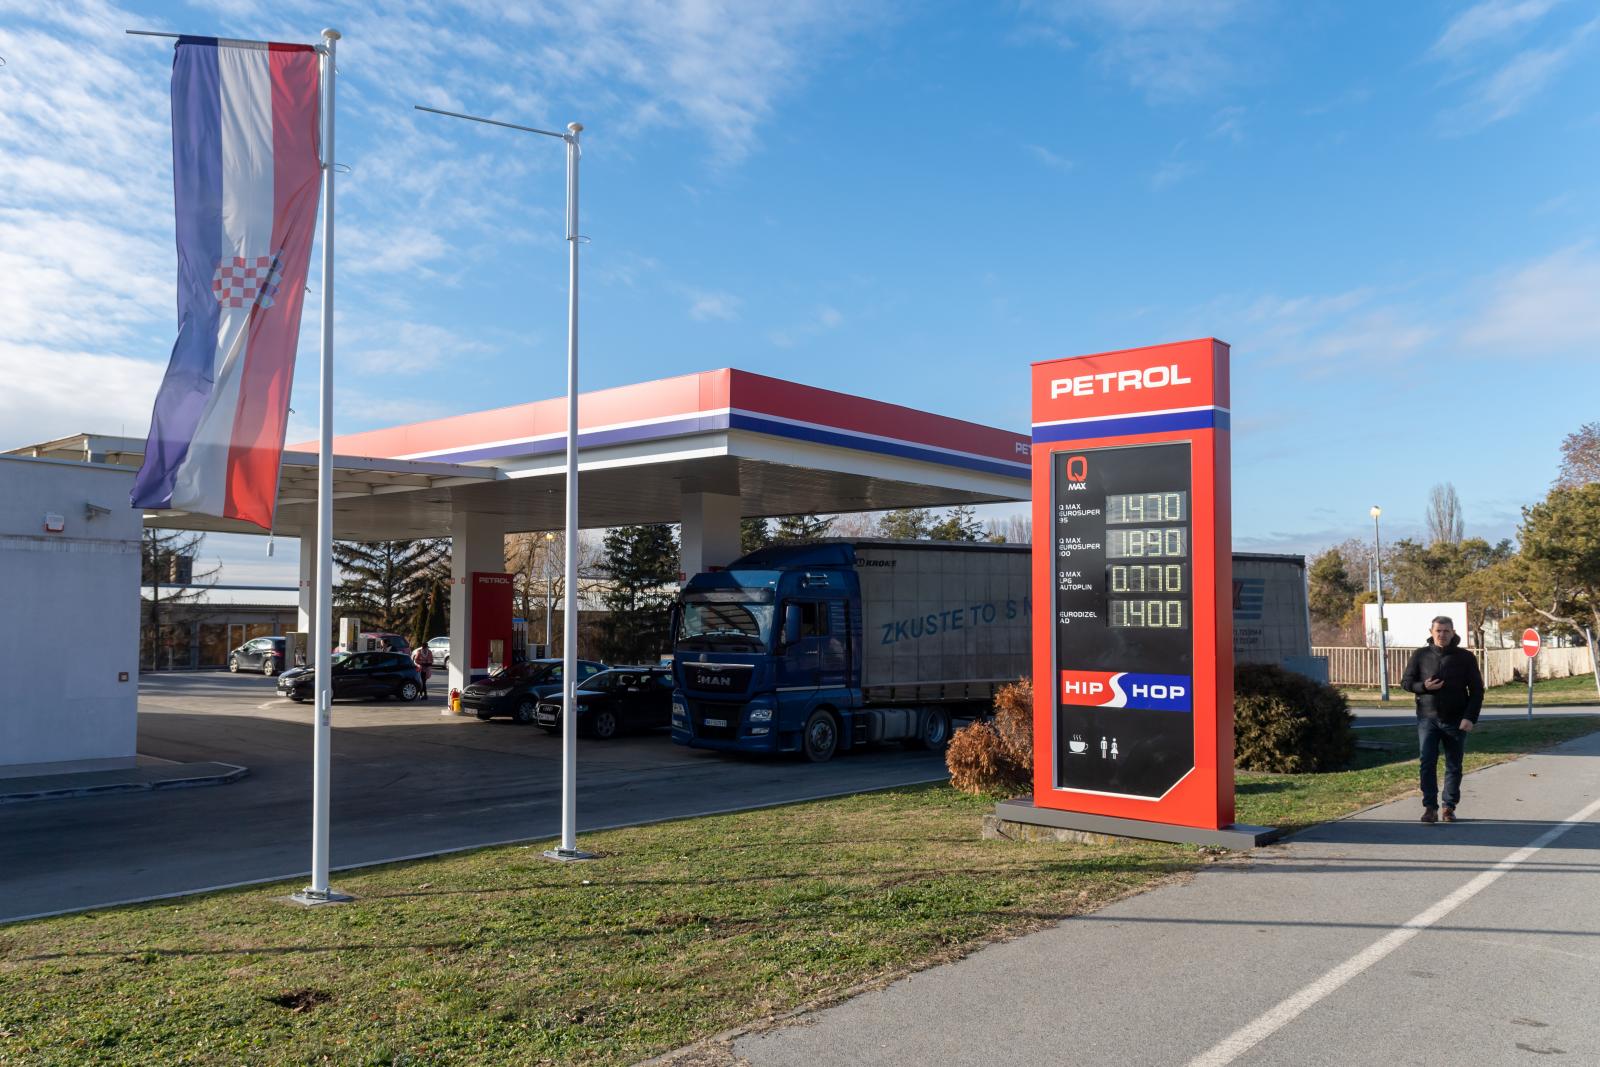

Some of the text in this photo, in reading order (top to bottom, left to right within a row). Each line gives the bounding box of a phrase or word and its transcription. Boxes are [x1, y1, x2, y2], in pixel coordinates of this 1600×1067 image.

[1051, 364, 1191, 399] PETROL
[1066, 456, 1088, 482] Q
[1068, 482, 1087, 491] MAX
[866, 559, 897, 567] KRONE
[479, 576, 510, 584] PETROL
[881, 608, 964, 644] ZKUSTE
[970, 603, 996, 625] TO
[1005, 599, 1017, 620] S
[700, 675, 732, 686] MAN
[1065, 681, 1104, 695] HIP
